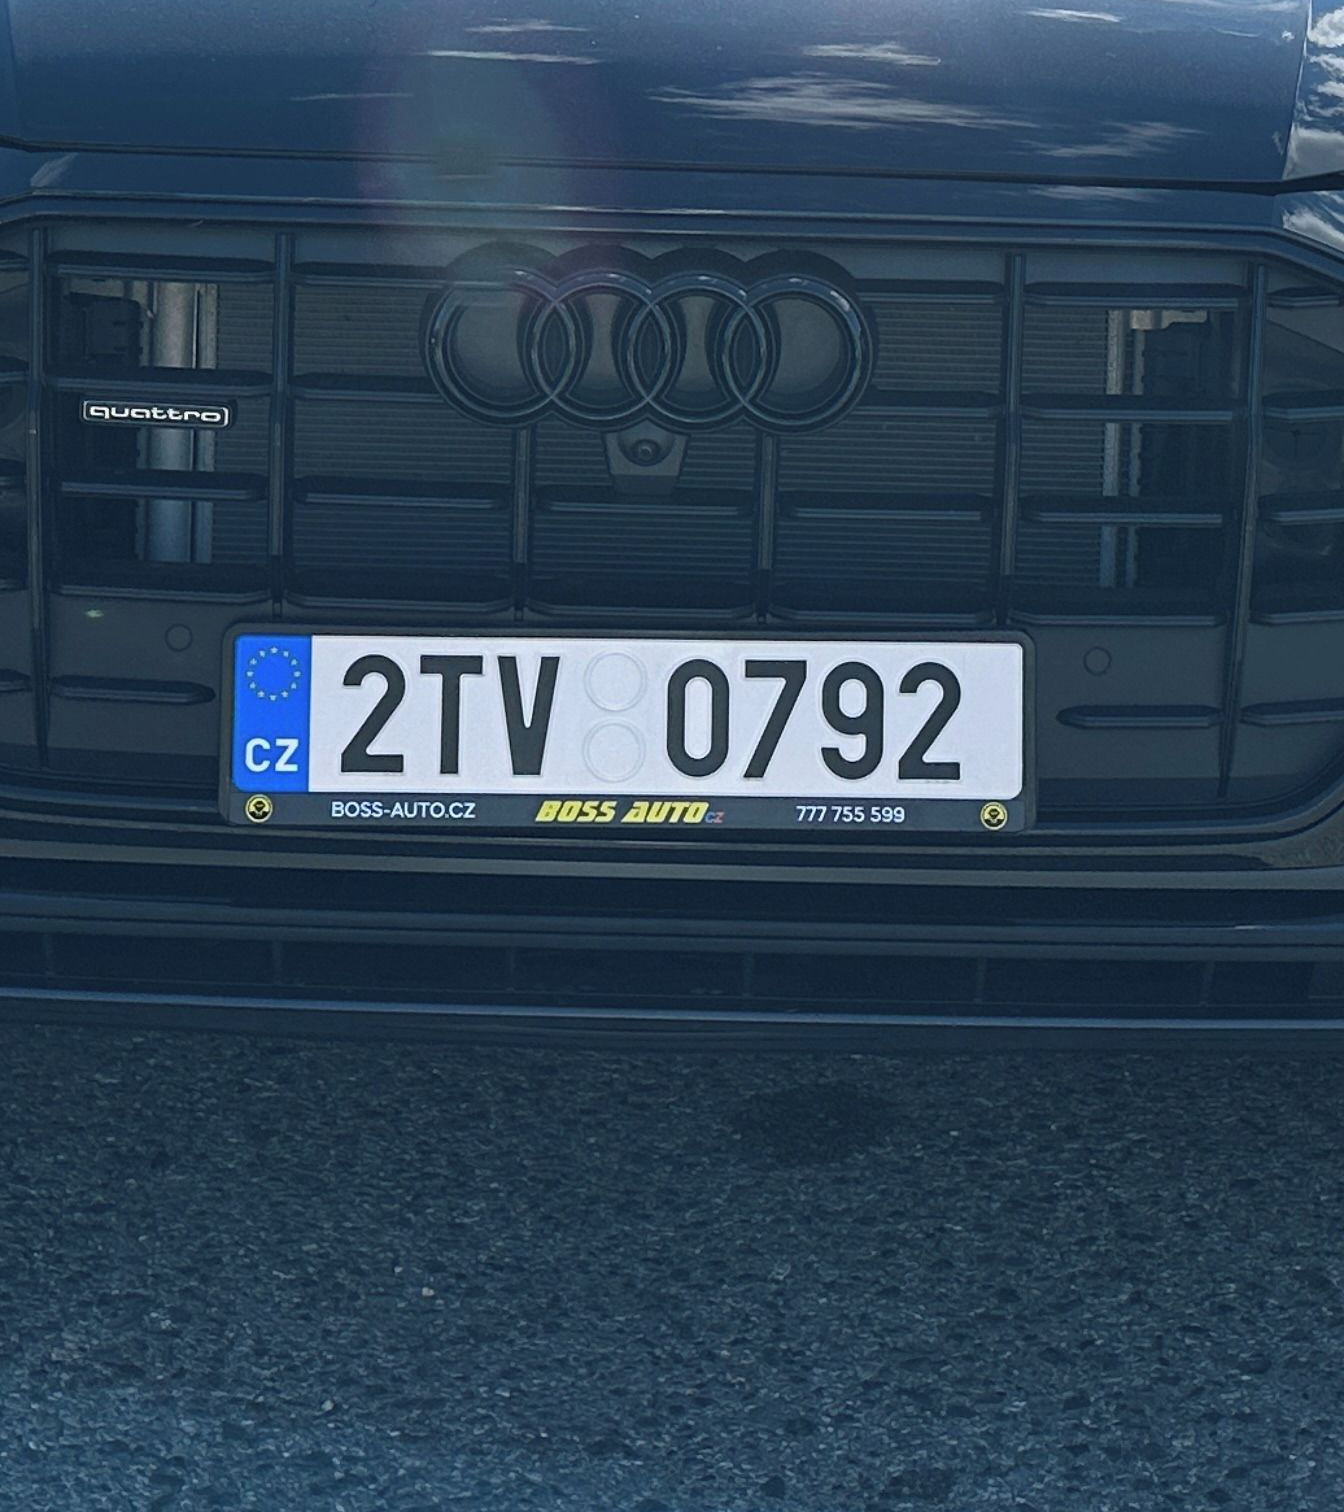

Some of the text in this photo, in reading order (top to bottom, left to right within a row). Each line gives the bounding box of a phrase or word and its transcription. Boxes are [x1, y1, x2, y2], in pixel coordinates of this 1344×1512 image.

[89, 405, 221, 422] quattro
[340, 653, 963, 781] 2TV 0792
[245, 738, 299, 773] CZ
[330, 800, 477, 820] BOSS-AUTO.CZ
[535, 800, 617, 824] BOSS
[621, 800, 709, 824] AUTO
[796, 806, 906, 824] 777 755 599
